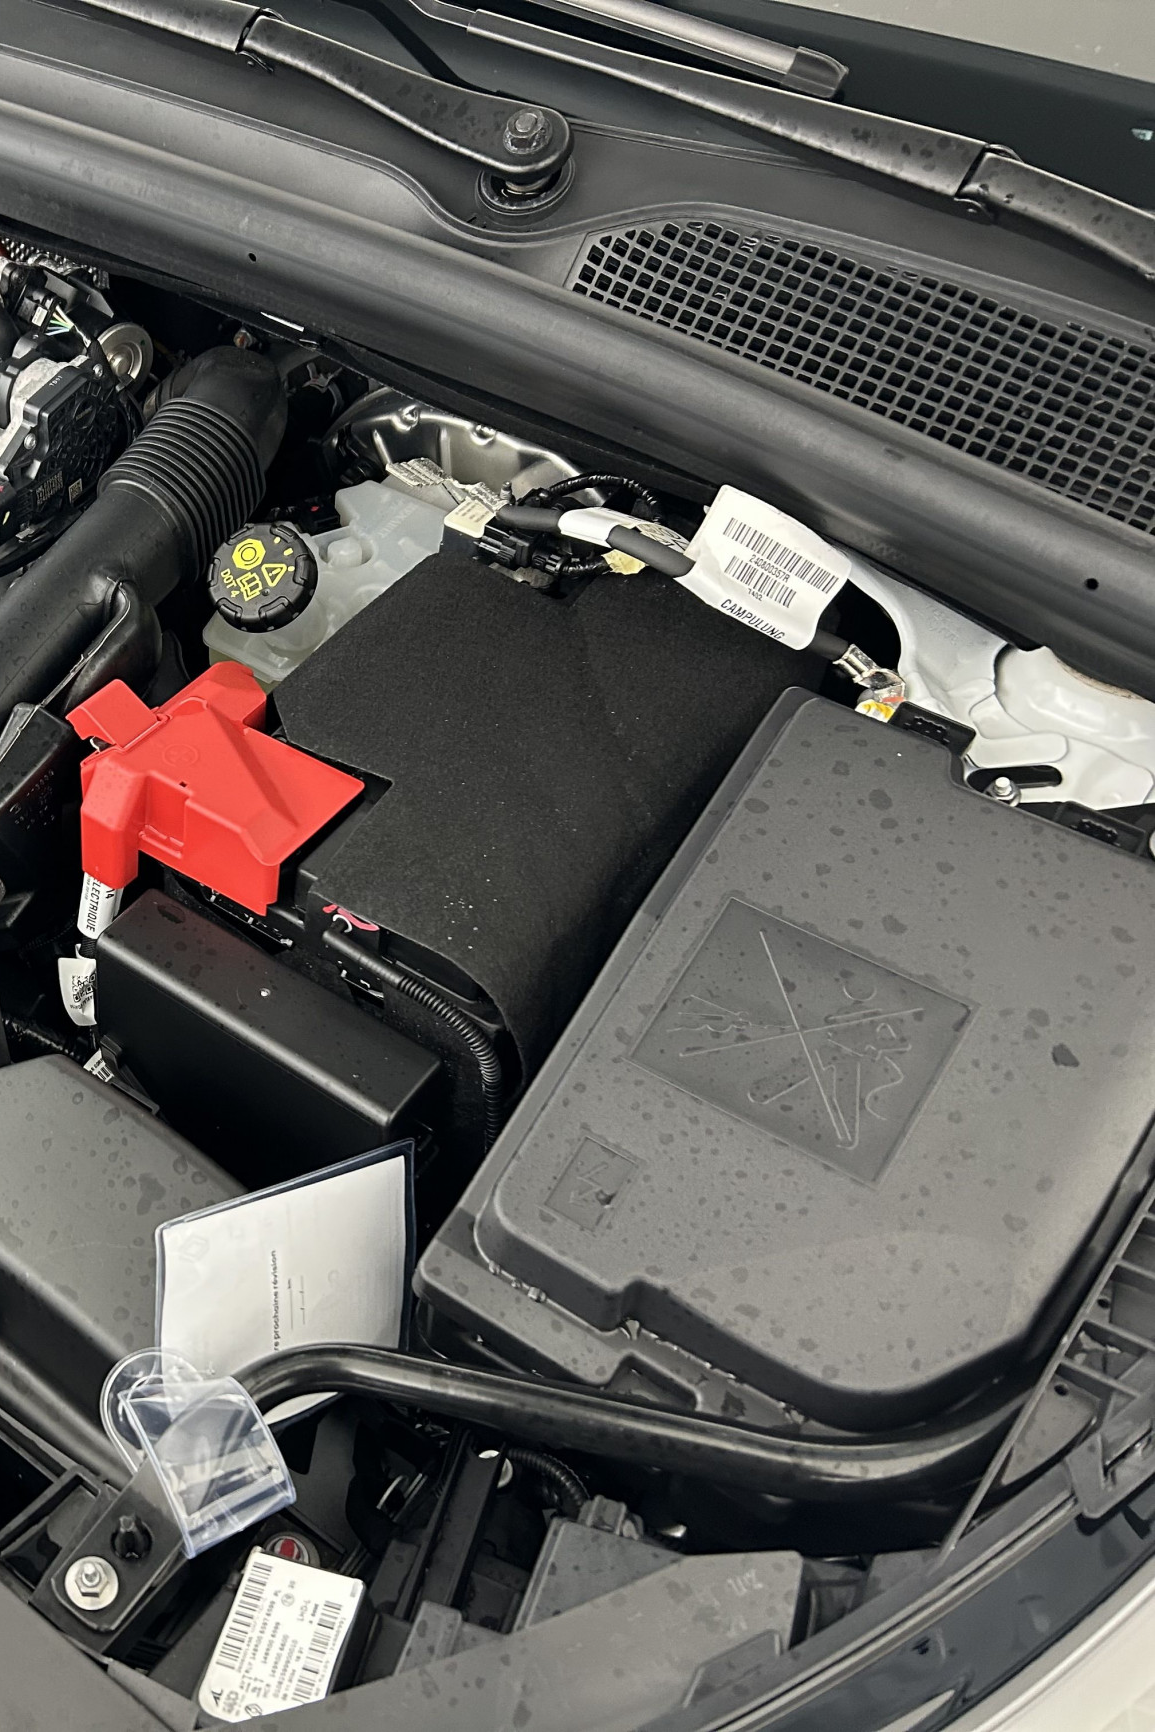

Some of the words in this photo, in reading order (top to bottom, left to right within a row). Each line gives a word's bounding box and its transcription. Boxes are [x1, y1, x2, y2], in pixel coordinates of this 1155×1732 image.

[219, 567, 236, 589] DOT
[230, 589, 239, 598] 4
[719, 596, 787, 640] CAMPULUNG
[270, 1249, 278, 1289] révision
[271, 1290, 281, 1339] prochaine
